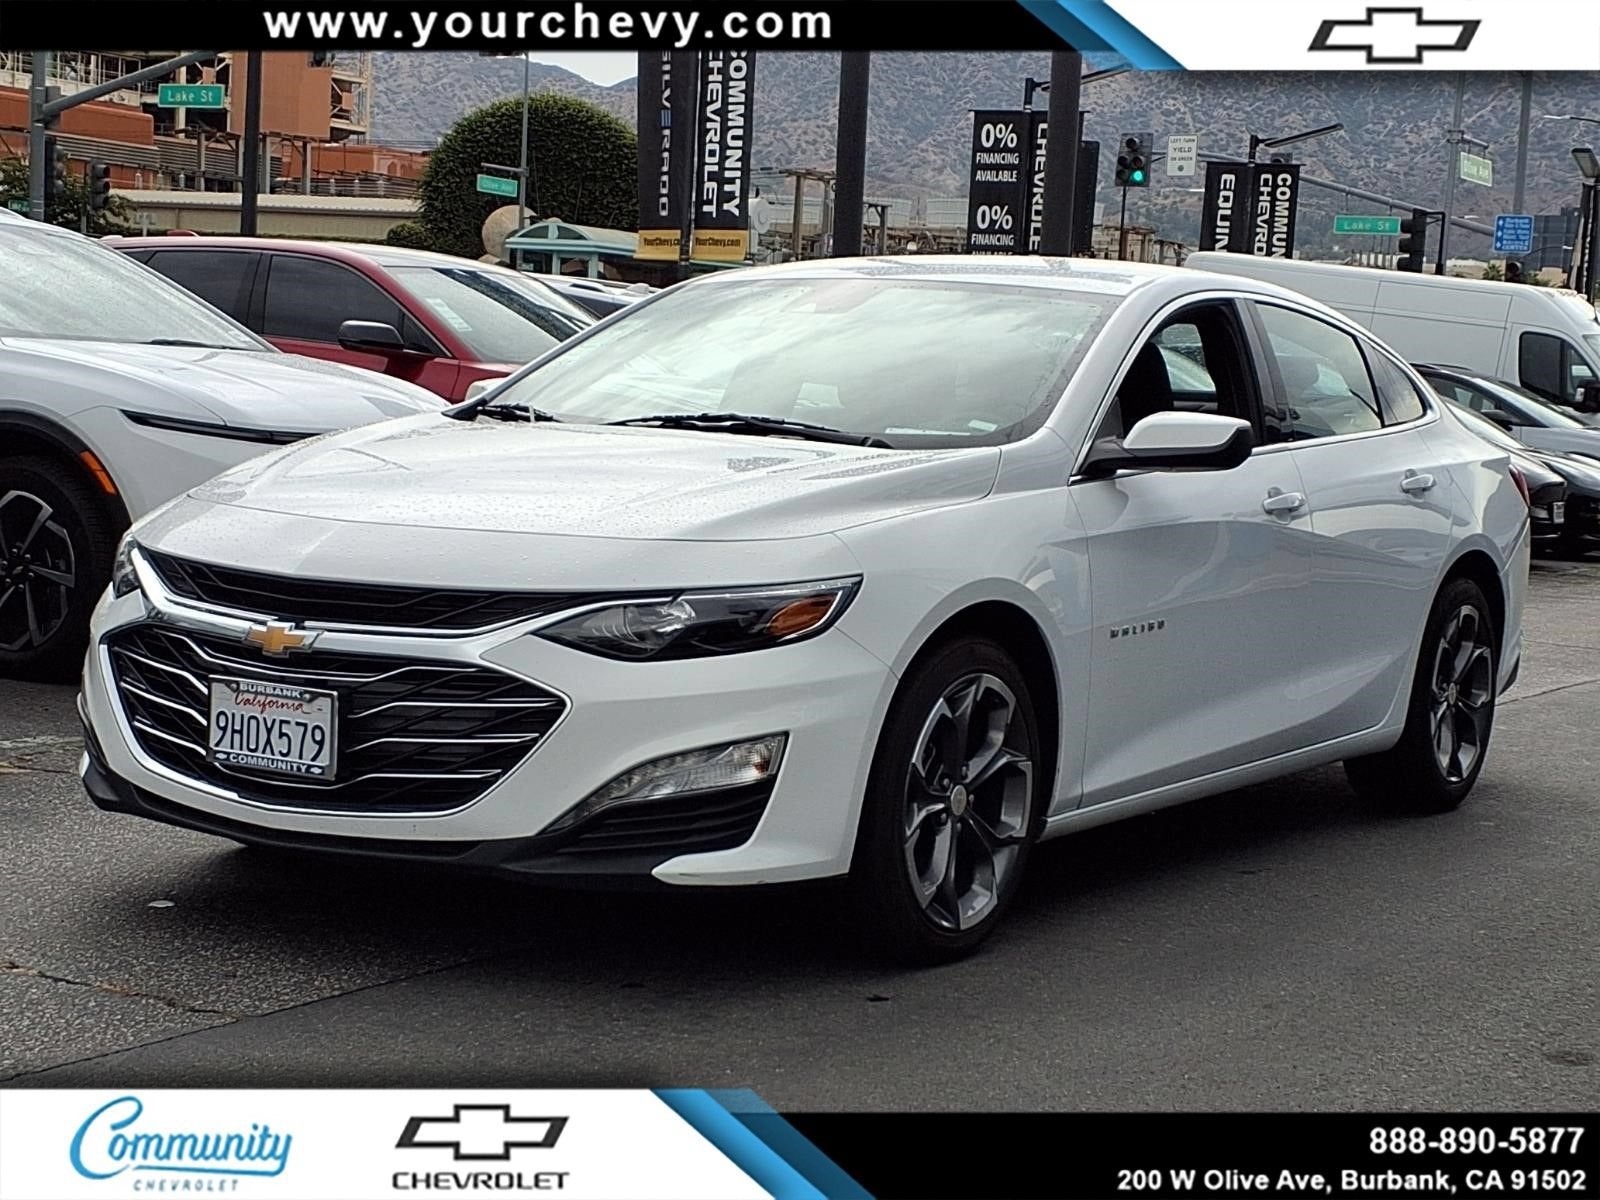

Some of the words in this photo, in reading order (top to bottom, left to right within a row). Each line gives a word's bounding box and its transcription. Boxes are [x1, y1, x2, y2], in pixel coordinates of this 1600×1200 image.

[167, 89, 195, 102] Lake
[200, 89, 213, 102] St
[981, 123, 1018, 148] 0%
[976, 152, 1019, 164] FINANCING
[975, 170, 1017, 182] AVAILABLE
[976, 205, 1013, 230] 0%
[1343, 221, 1372, 230] Lake
[1377, 221, 1391, 231] St
[971, 234, 1015, 246] FINANCING
[240, 682, 301, 698] BURBANK
[234, 691, 306, 714] California
[229, 753, 308, 774] COMMUNITY
